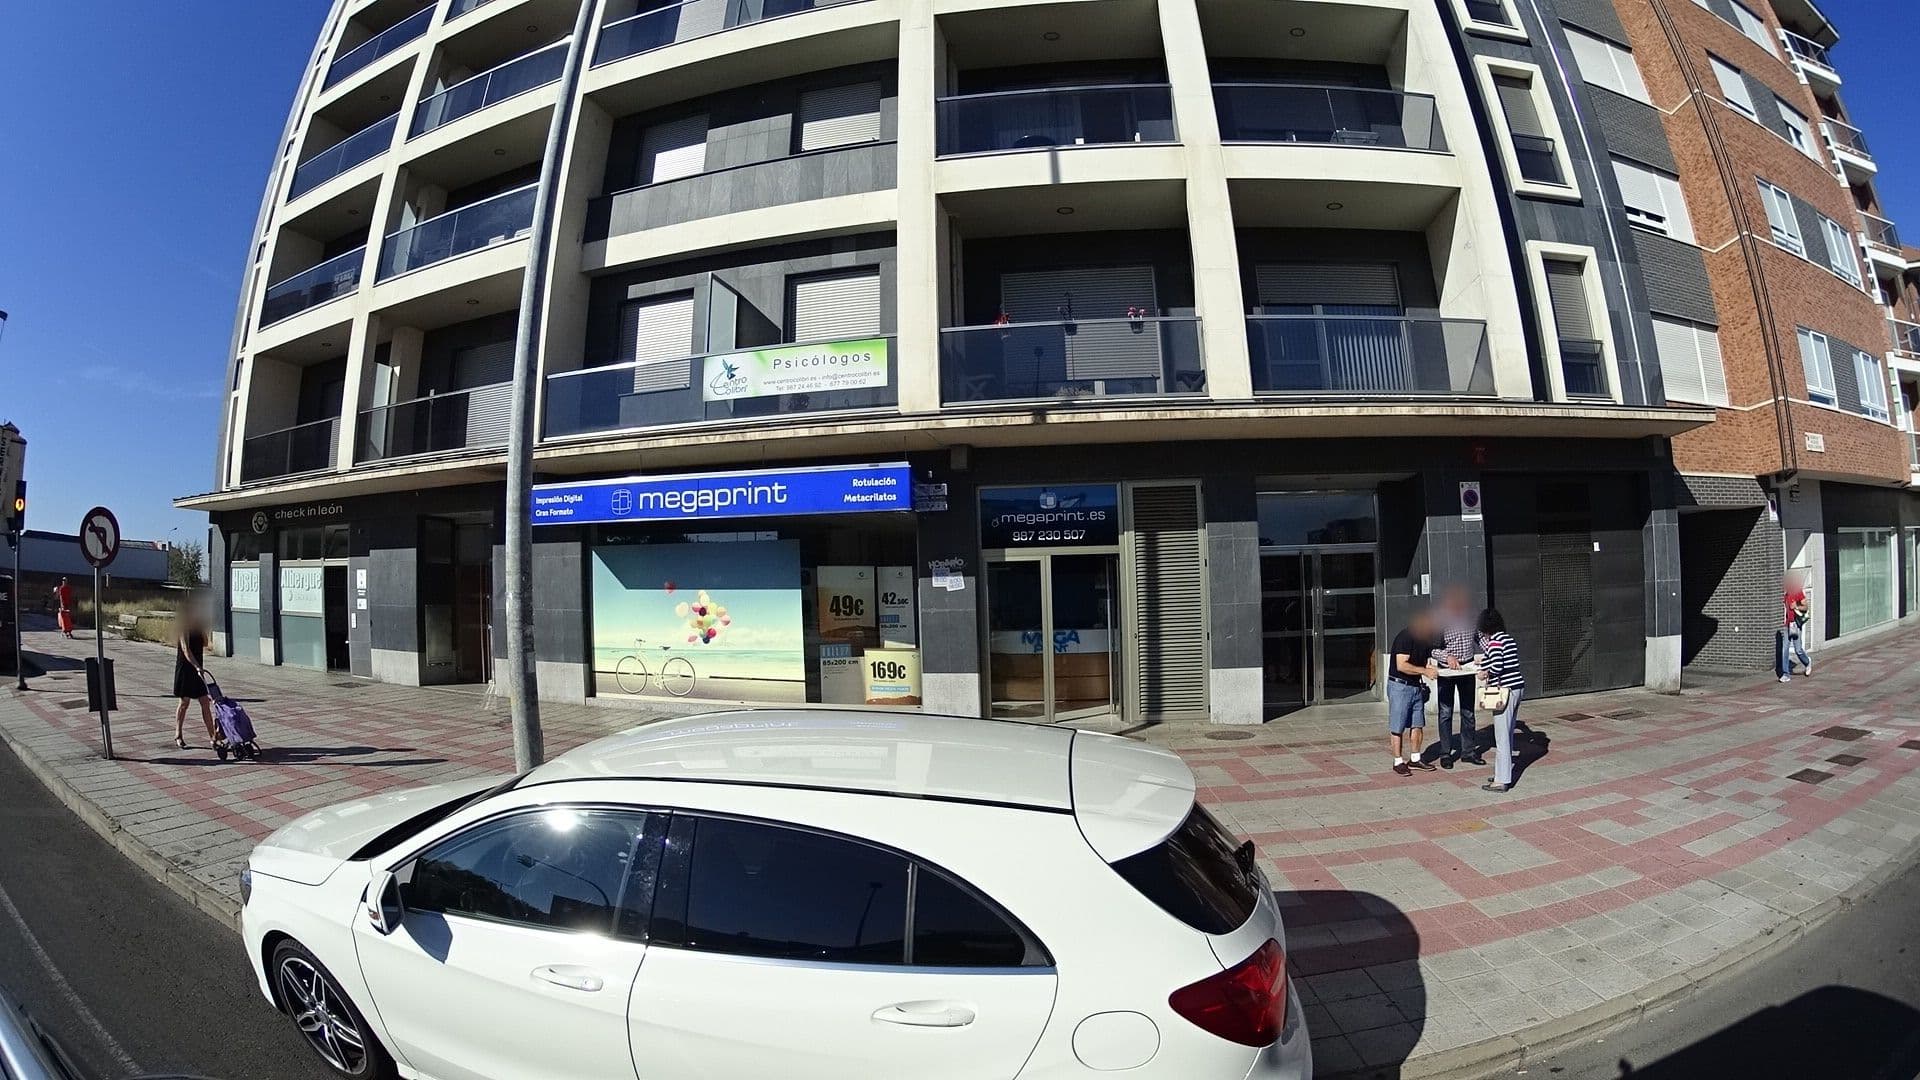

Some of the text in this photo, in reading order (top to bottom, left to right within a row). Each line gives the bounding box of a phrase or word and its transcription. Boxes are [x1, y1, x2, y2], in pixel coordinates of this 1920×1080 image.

[773, 351, 871, 370] Psicólogos
[852, 477, 897, 488] Rotulación
[563, 493, 584, 504] Digital
[639, 481, 787, 513] megaprint
[843, 492, 897, 503] Metacrilatos
[274, 503, 343, 519] check in león
[549, 507, 574, 517] Formato
[1001, 510, 1106, 525] megaprint.es
[1012, 529, 1086, 541] 987 230 507
[281, 569, 323, 592] Albergue
[829, 595, 865, 616] 49€
[870, 661, 906, 680] 169€
